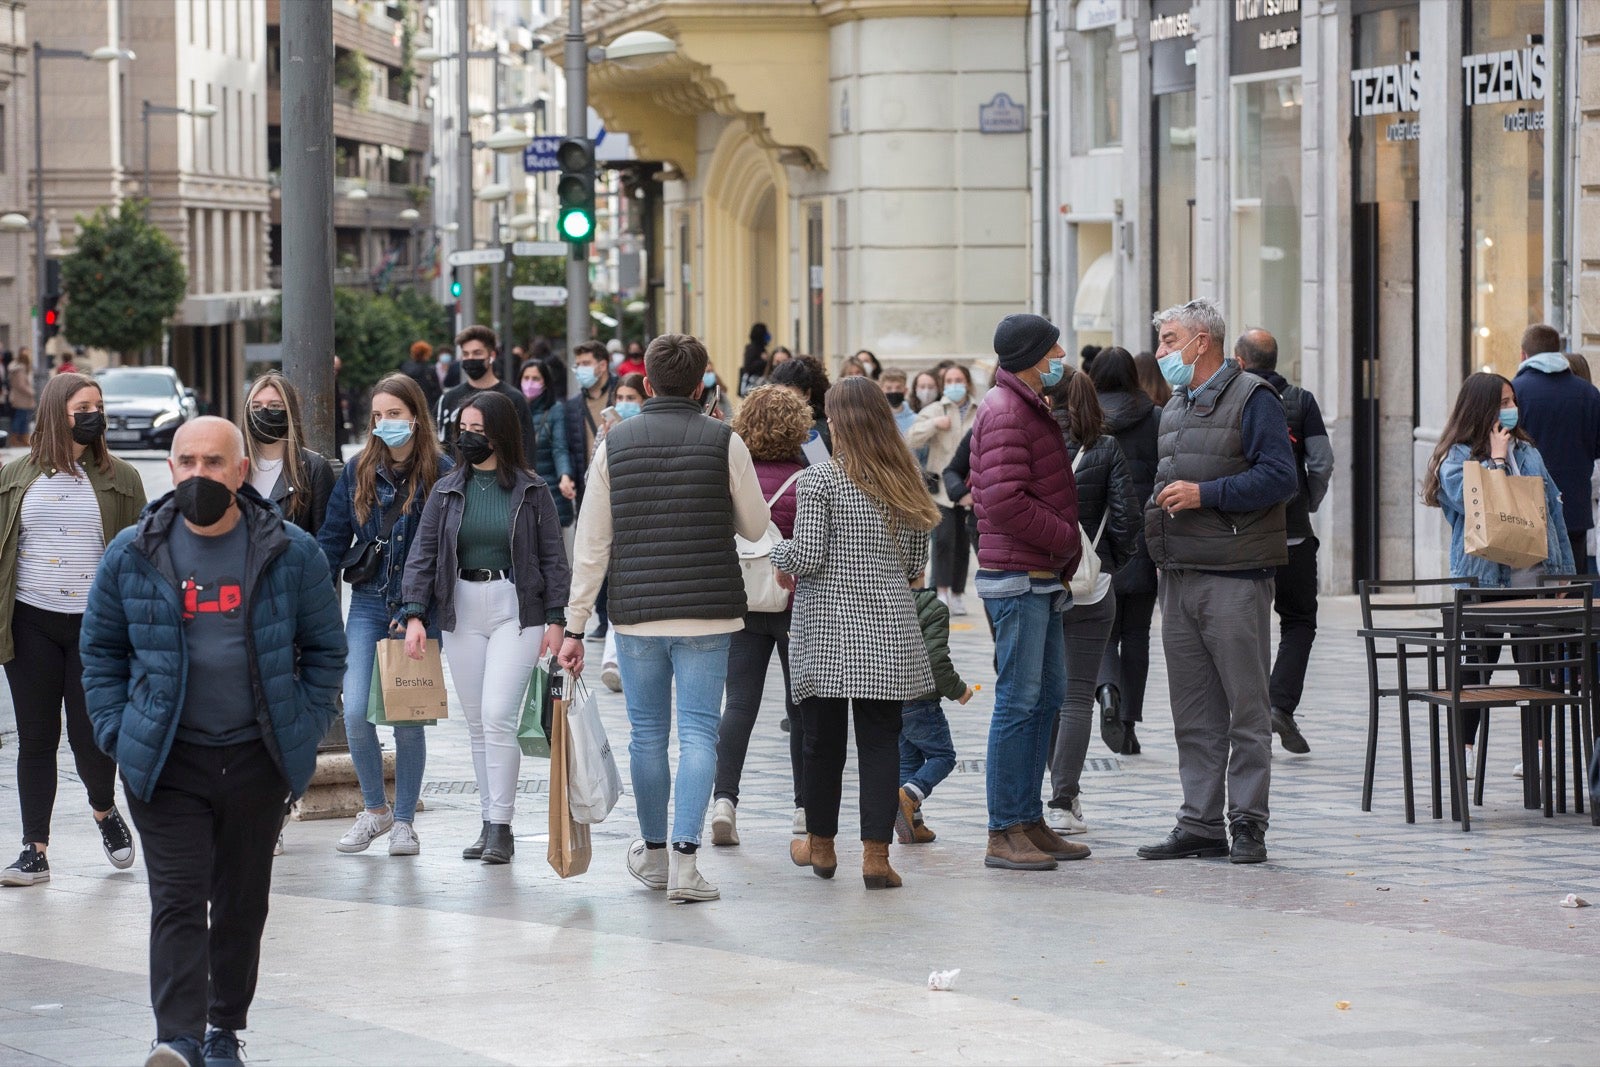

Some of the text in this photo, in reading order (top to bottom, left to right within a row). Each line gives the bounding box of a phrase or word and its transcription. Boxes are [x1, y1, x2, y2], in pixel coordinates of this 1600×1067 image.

[1386, 119, 1420, 142] underwea
[1503, 110, 1544, 132] underwea
[395, 677, 434, 687] Bershka
